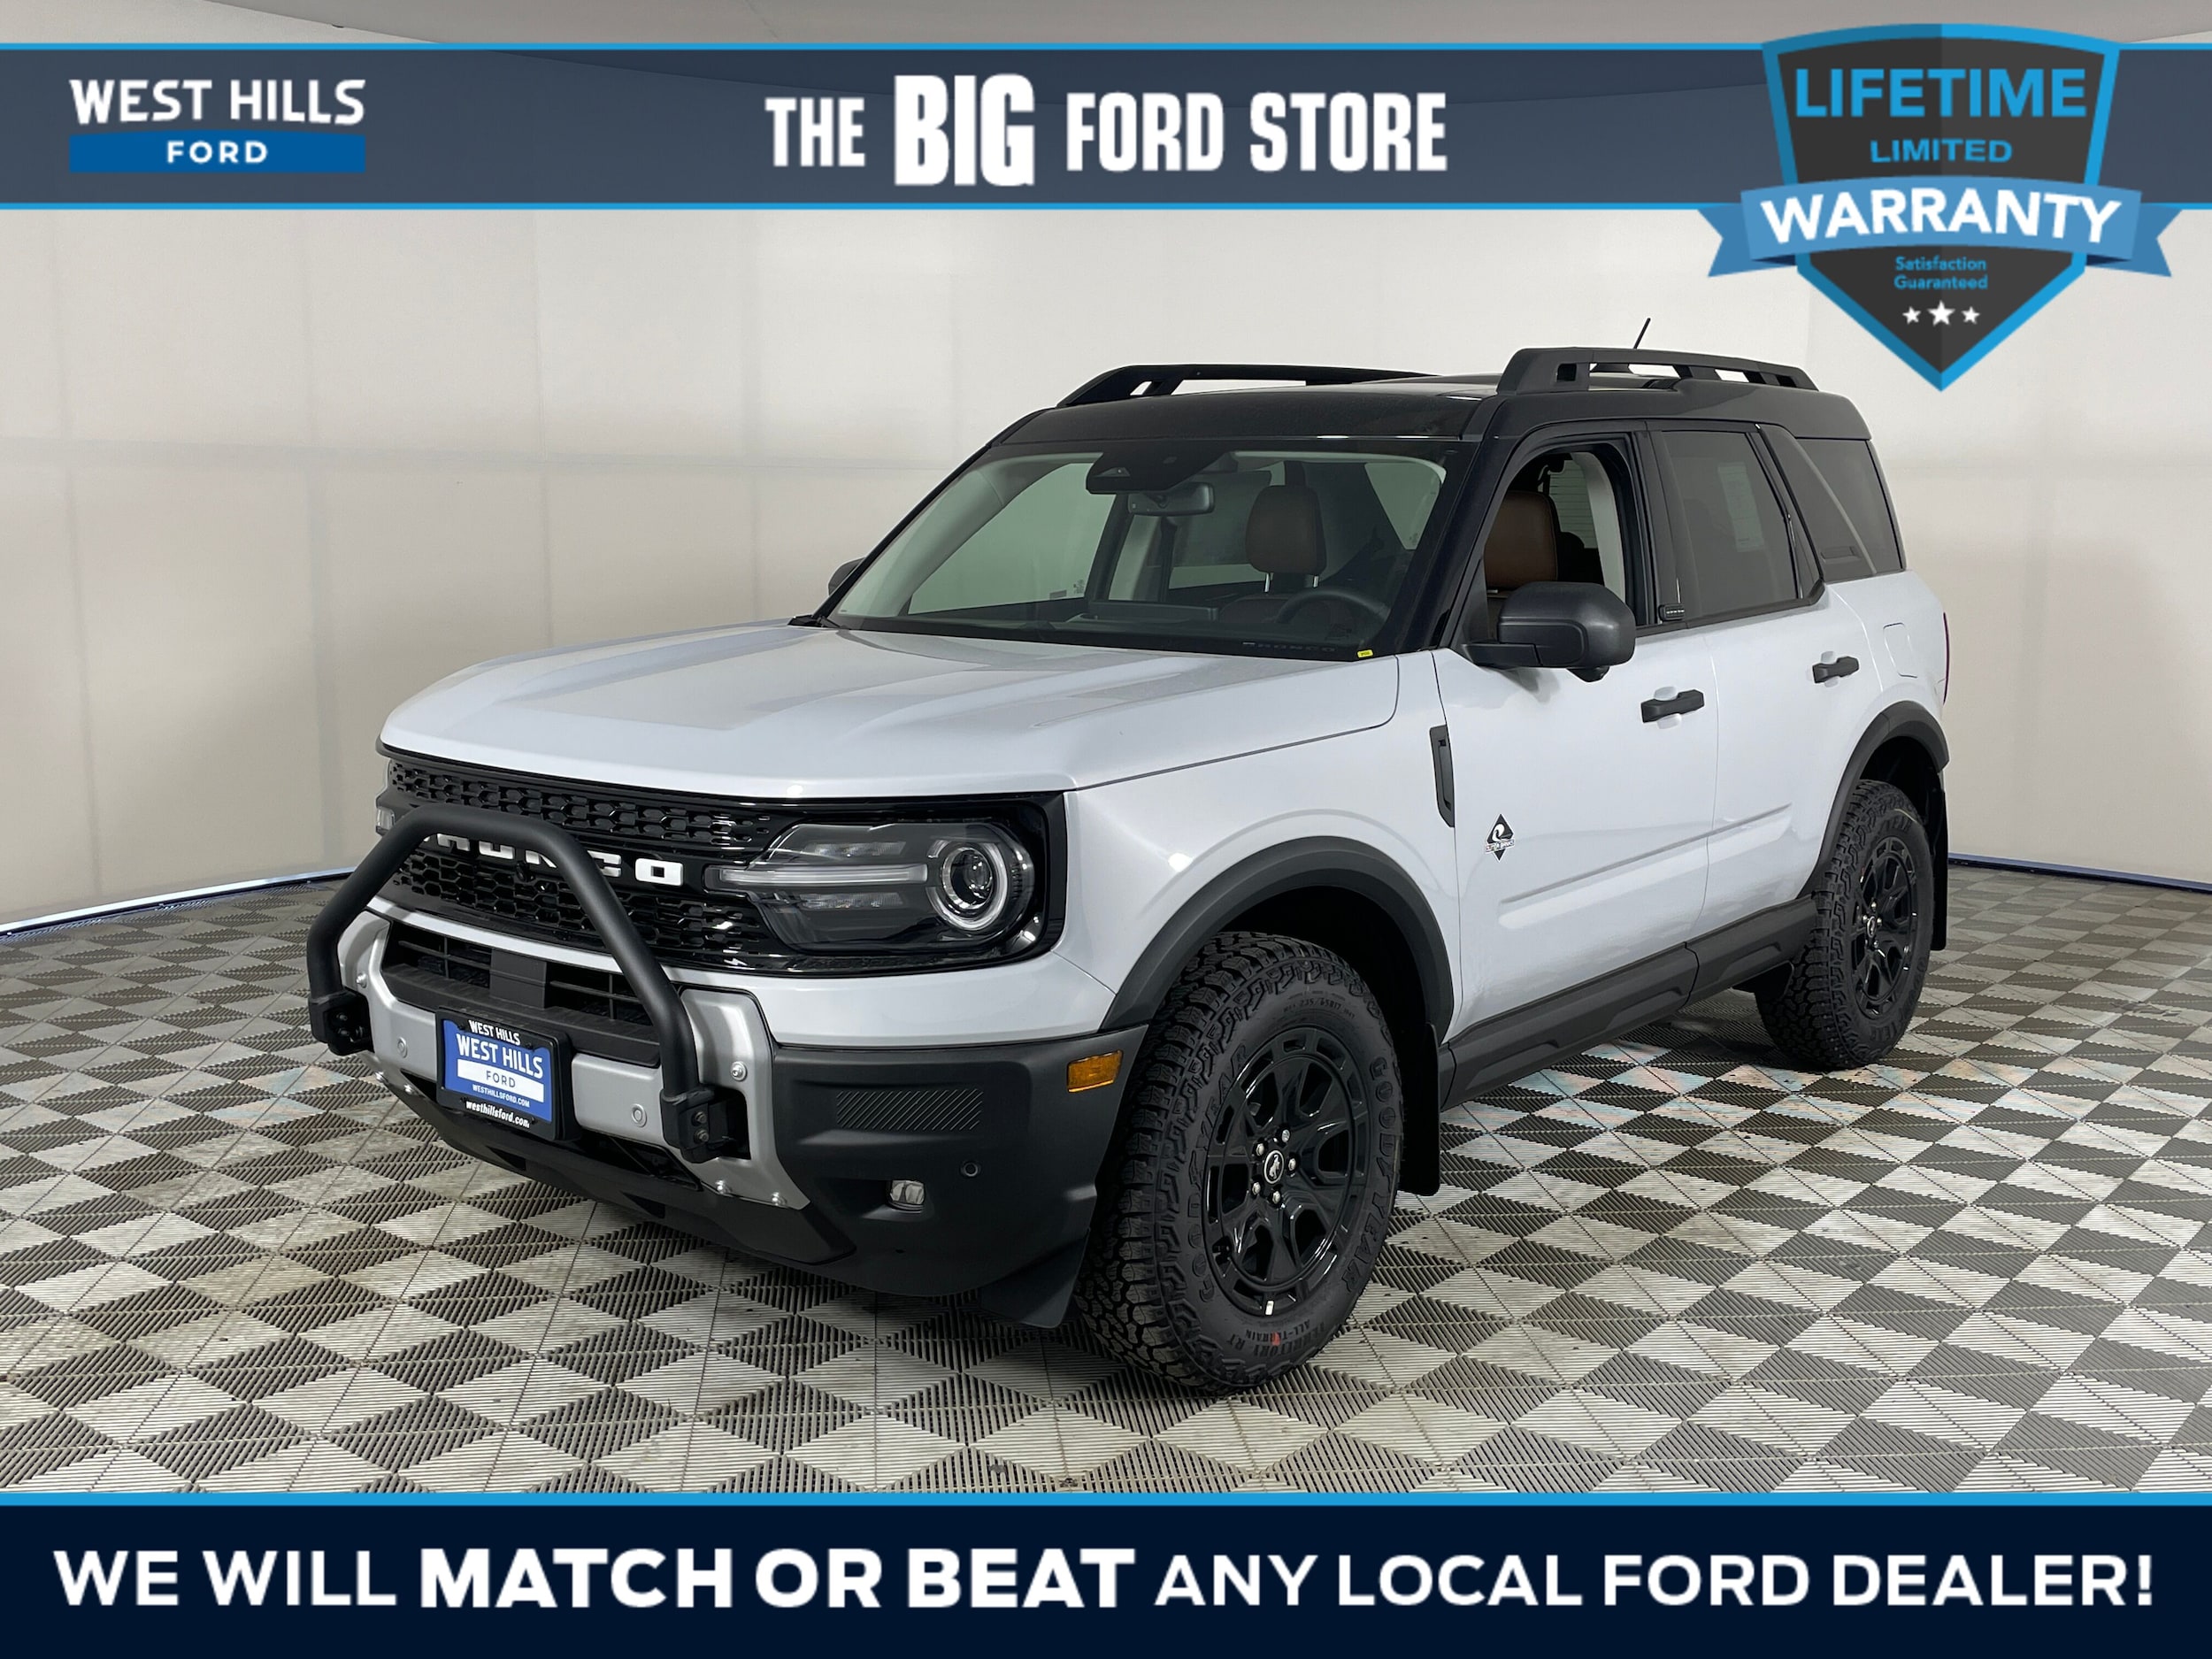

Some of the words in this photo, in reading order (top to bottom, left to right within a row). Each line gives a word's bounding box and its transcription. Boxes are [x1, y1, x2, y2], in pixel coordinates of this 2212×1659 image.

[422, 833, 684, 887] ROCO
[468, 1019, 495, 1038] WEST
[495, 1026, 521, 1047] HILLS
[456, 1033, 497, 1063] WEST
[503, 1047, 544, 1079] HILLS
[486, 1070, 516, 1088] FORD
[472, 1084, 530, 1108] WESTHILLSFORD.COM
[465, 1100, 530, 1129] westhillsford.com
[1340, 1056, 1396, 1294] GOODYEAR
